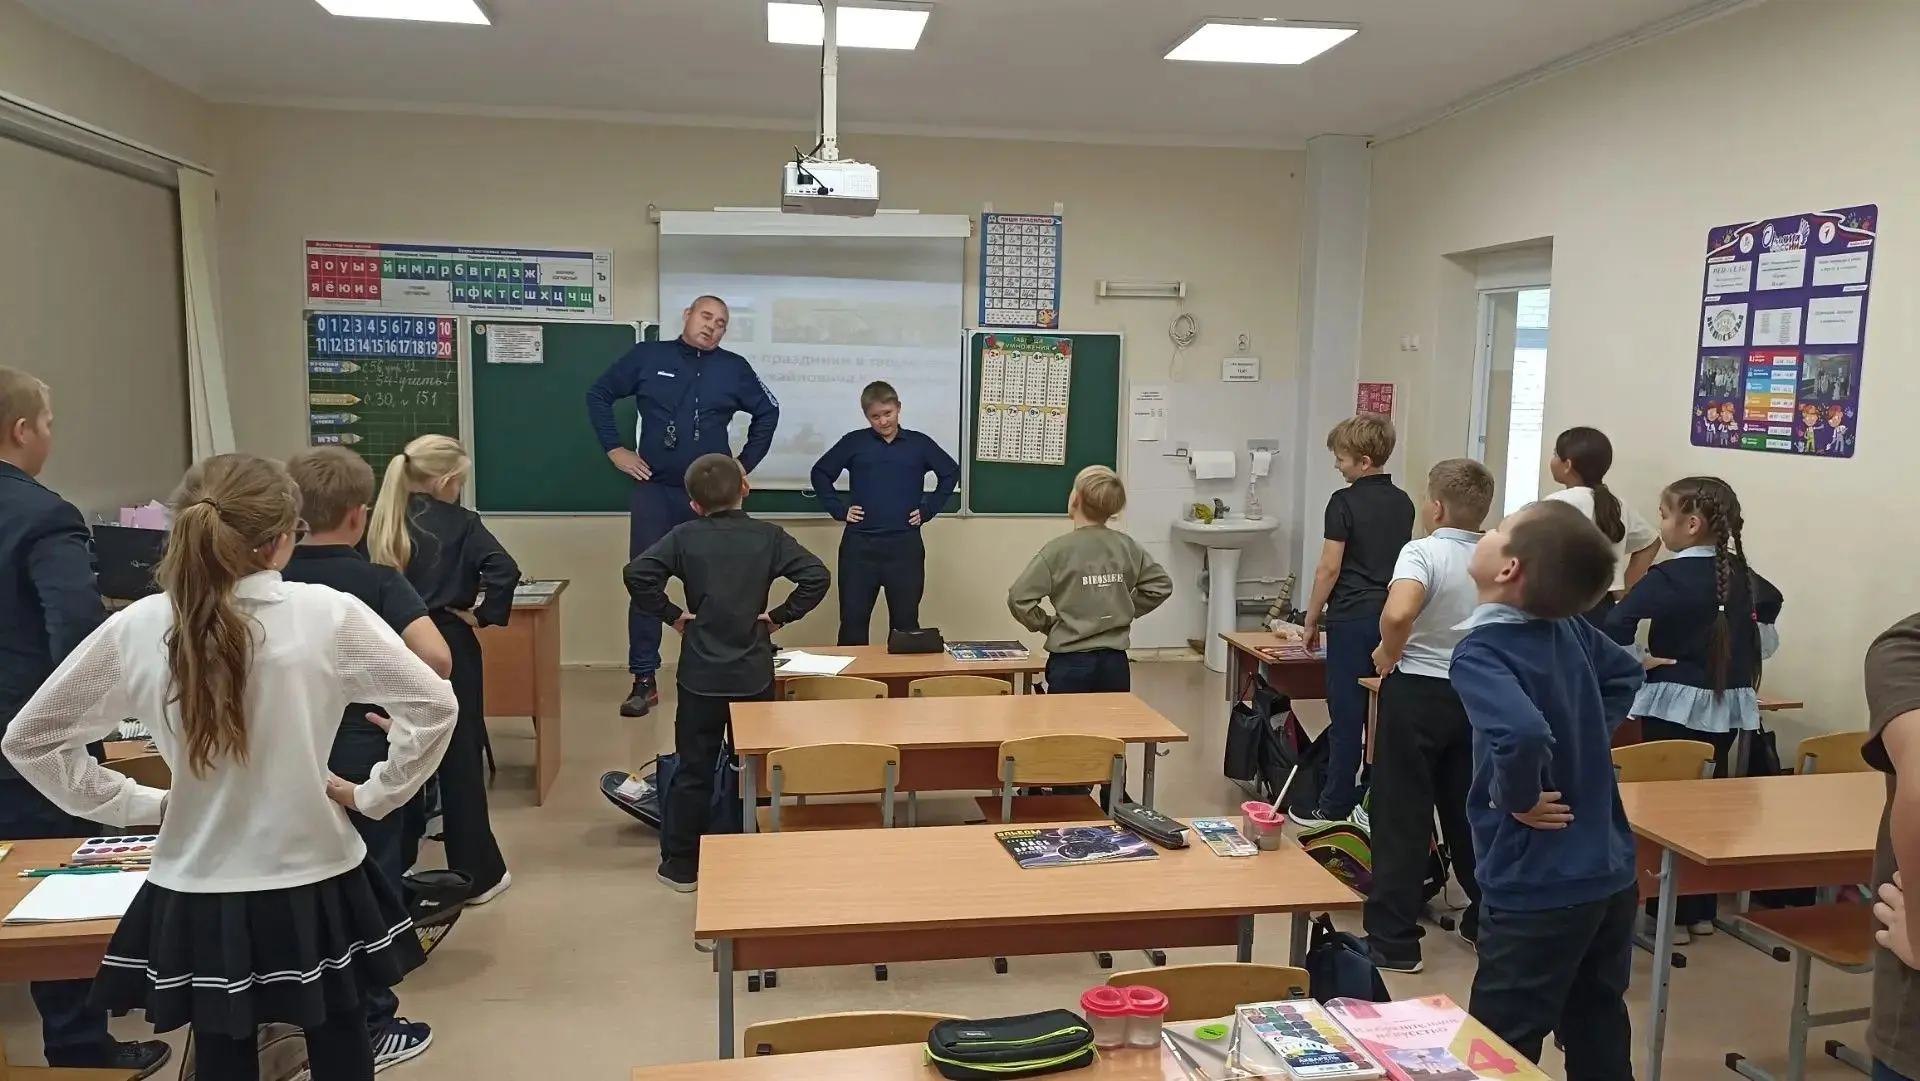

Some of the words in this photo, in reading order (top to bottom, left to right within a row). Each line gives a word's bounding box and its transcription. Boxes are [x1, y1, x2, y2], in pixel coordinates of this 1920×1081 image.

[318, 318, 325, 332] 0
[332, 319, 337, 332] 1
[343, 319, 350, 332] 2
[355, 319, 362, 333] 3
[368, 320, 375, 333] 4
[380, 320, 387, 334] 5
[392, 320, 399, 334] 6
[404, 320, 411, 334] 7
[416, 321, 423, 335] 8
[428, 321, 435, 335] 9
[440, 322, 450, 335] 10
[317, 338, 327, 351] 11
[330, 338, 341, 352] 12
[344, 339, 355, 352] 13
[358, 339, 369, 352] 14
[372, 339, 383, 353] 15
[386, 340, 396, 353] 16
[399, 340, 410, 354] 17
[412, 340, 424, 354] 18
[426, 341, 437, 355] 19
[439, 341, 451, 355] 20
[1468, 1038, 1521, 1075] 4
